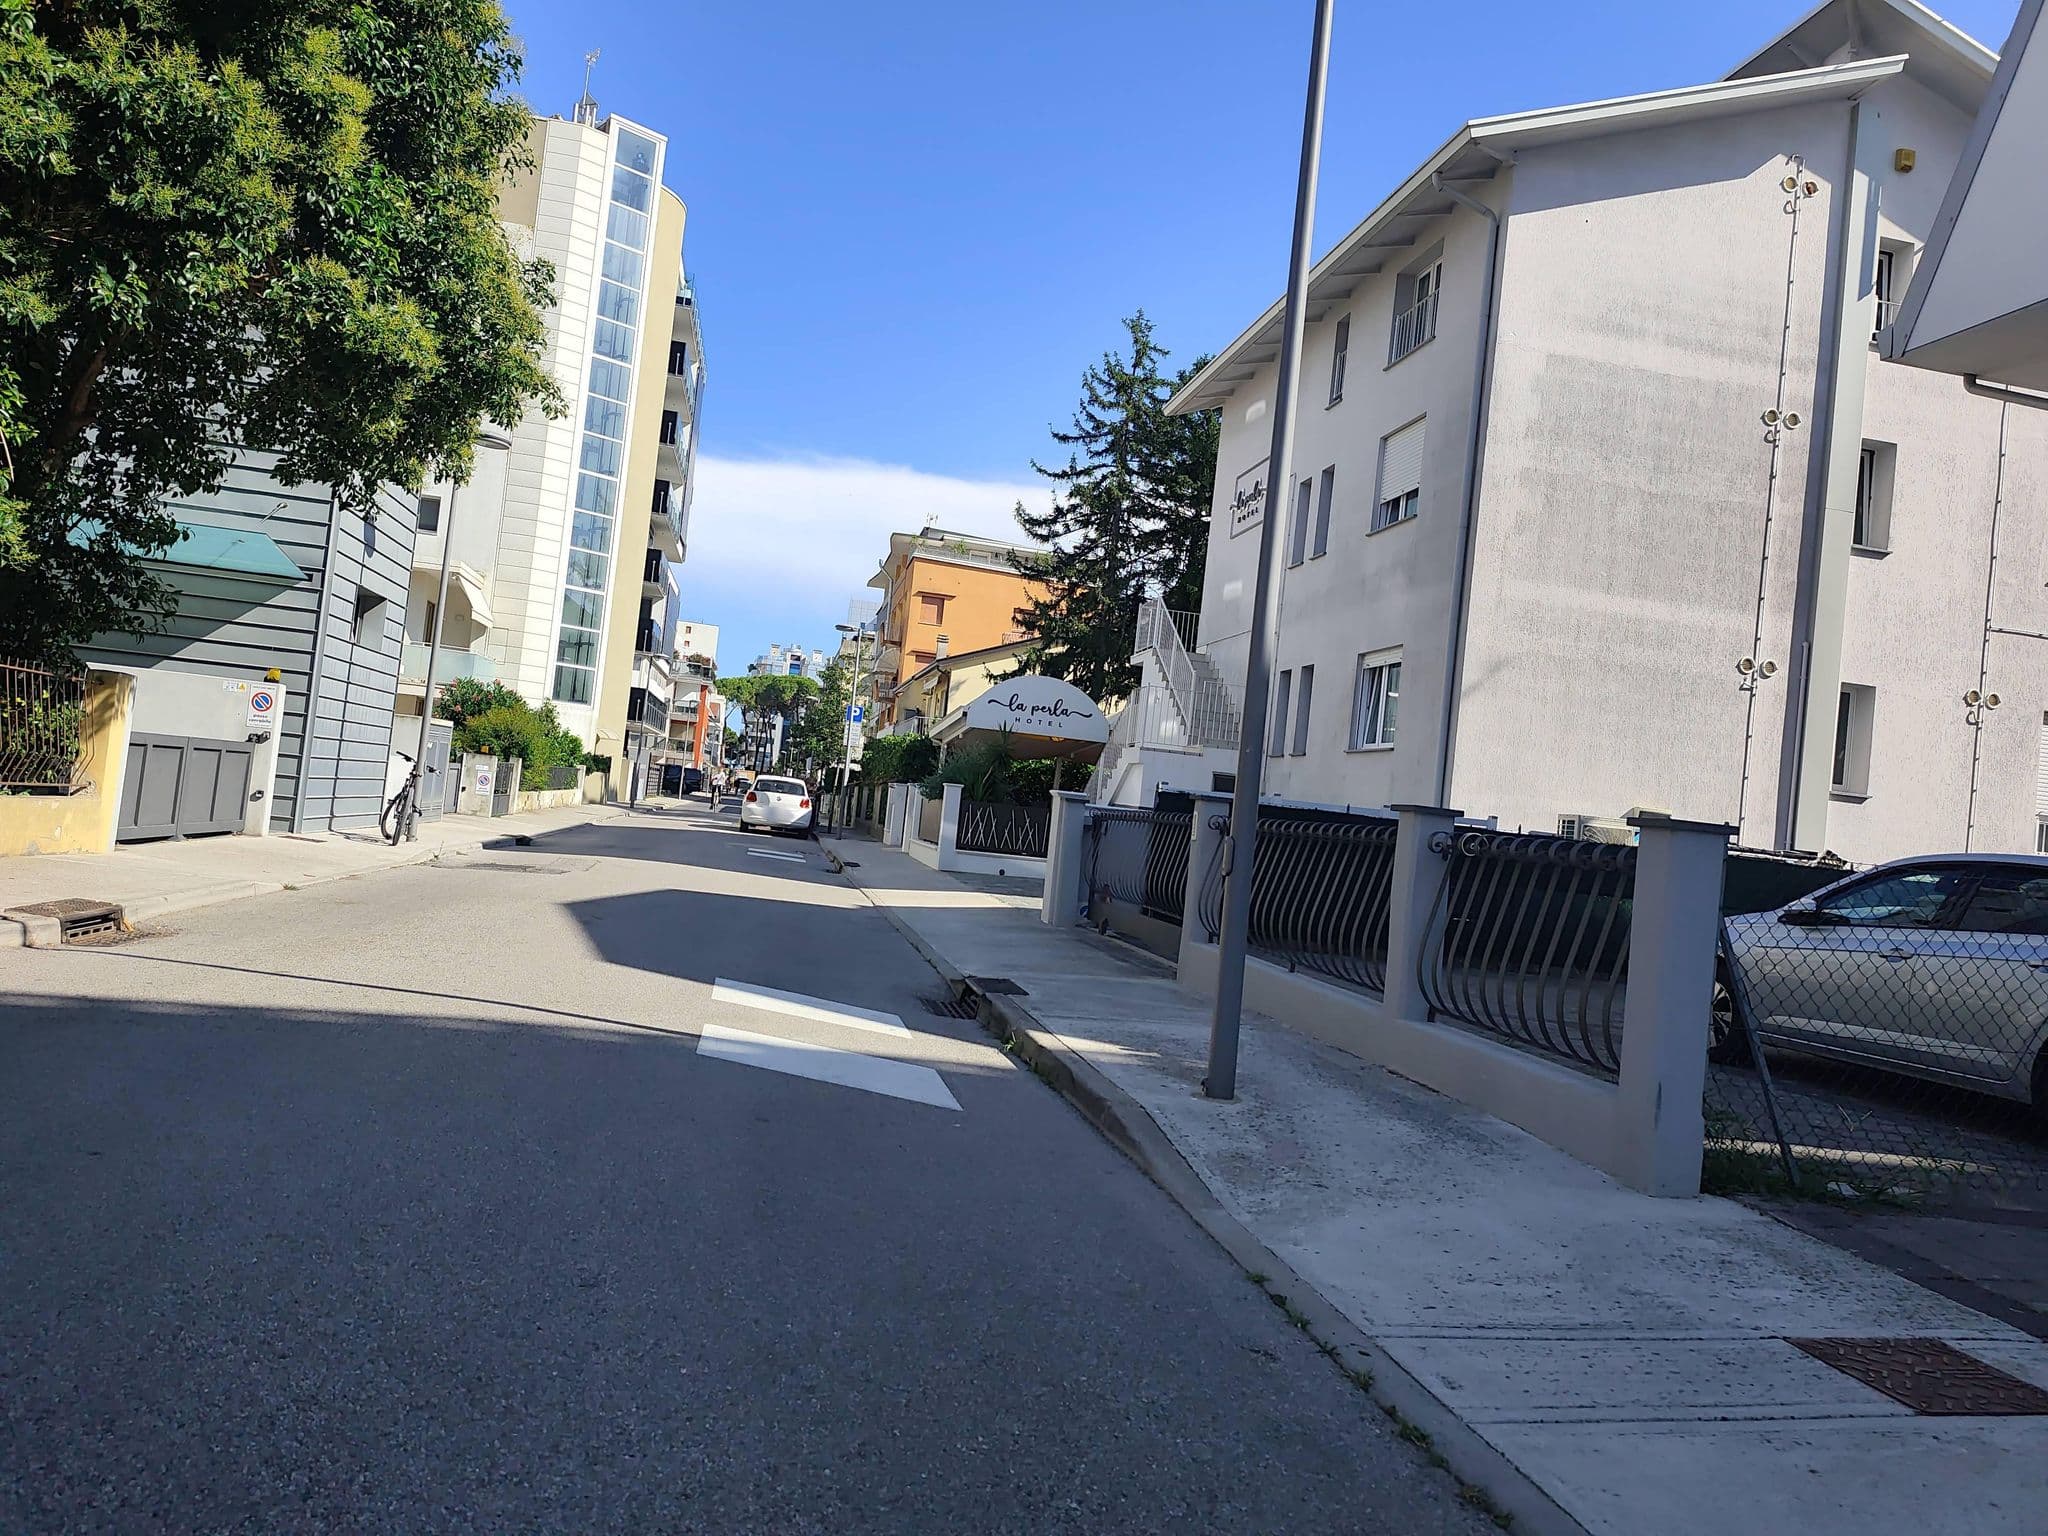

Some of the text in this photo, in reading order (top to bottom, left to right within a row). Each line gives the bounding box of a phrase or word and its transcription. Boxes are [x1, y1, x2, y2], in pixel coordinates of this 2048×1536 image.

[998, 693, 1090, 718] la perla
[1015, 717, 1063, 728] HOTEL
